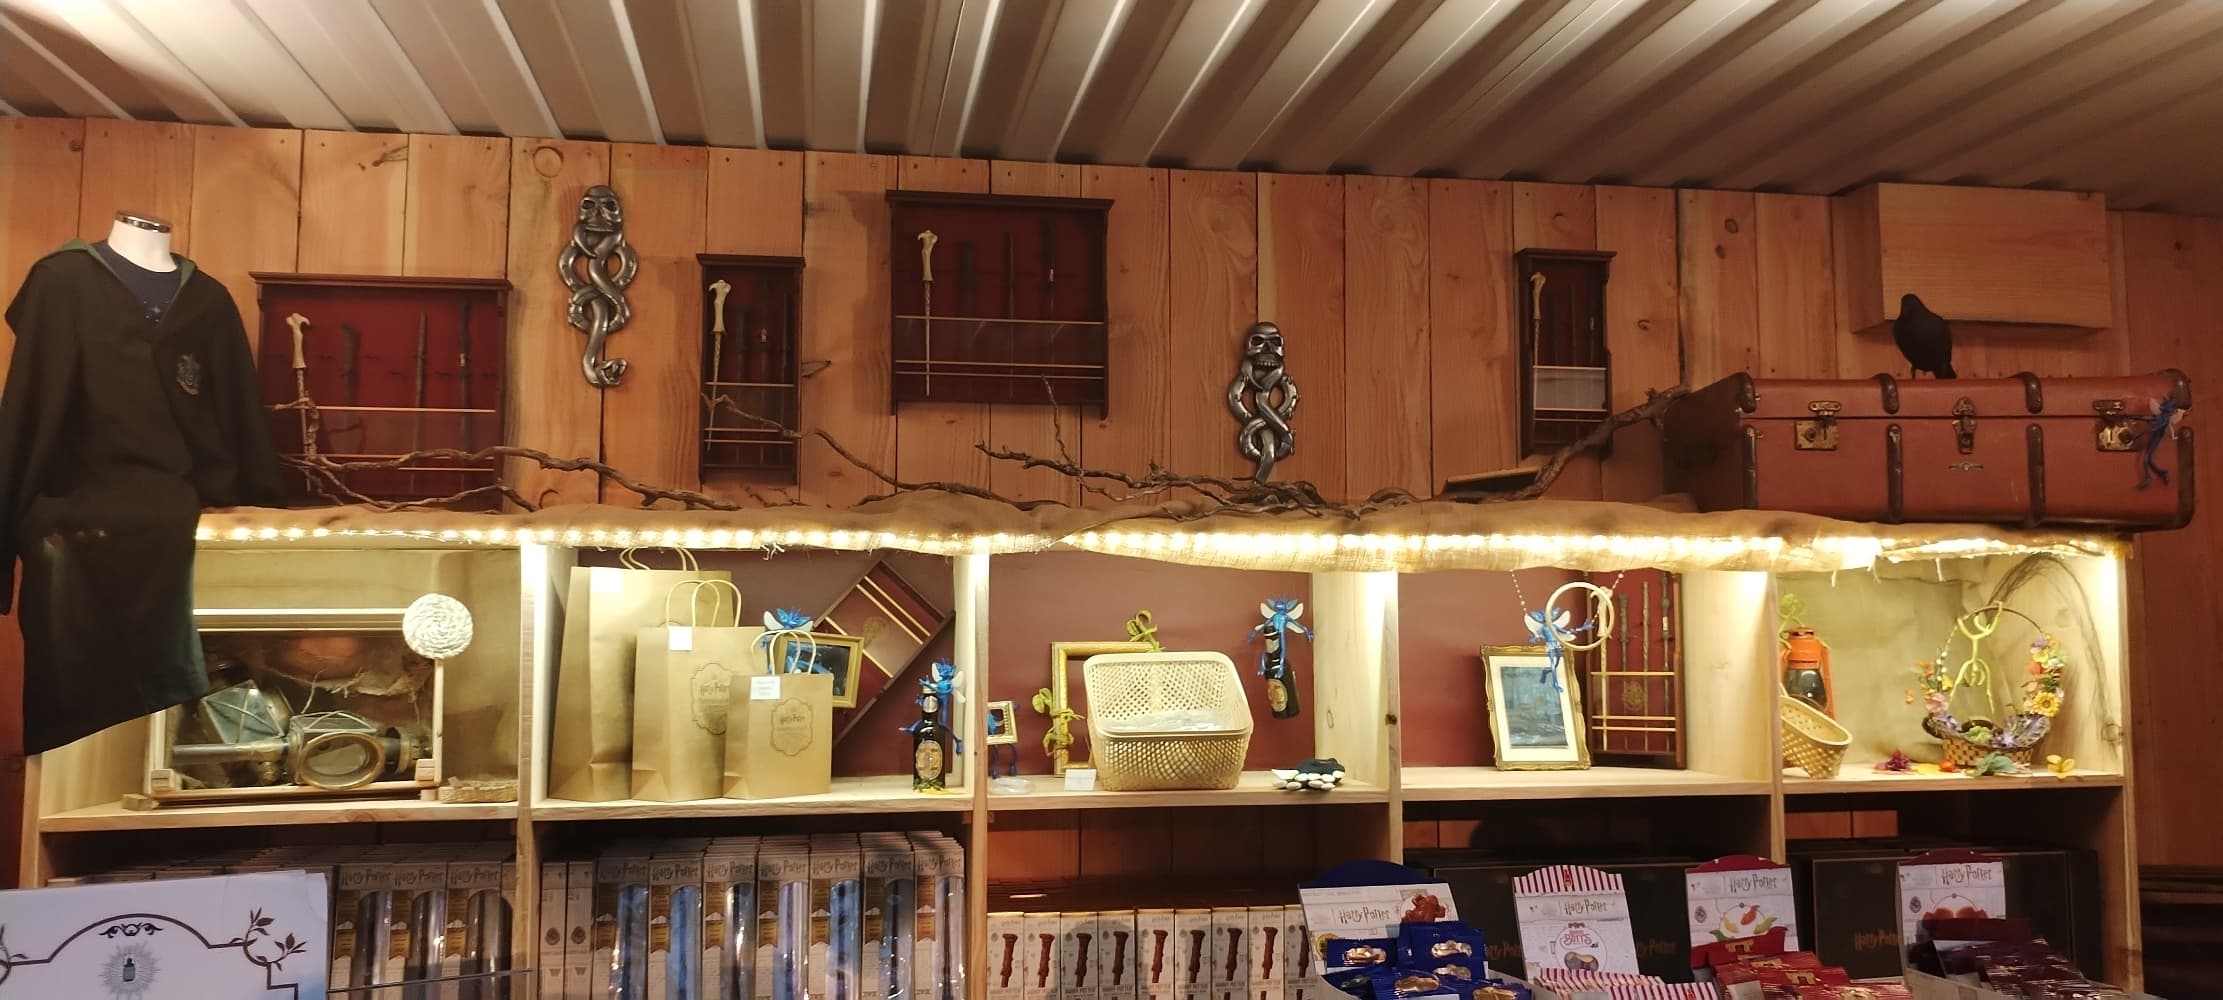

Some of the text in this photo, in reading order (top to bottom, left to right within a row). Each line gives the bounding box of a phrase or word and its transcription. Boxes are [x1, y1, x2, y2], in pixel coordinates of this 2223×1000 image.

[1730, 874, 1777, 893] Harry Potter
[1942, 865, 1992, 885] Harry Potter
[1339, 906, 1390, 924] Harry Potter
[1564, 899, 1607, 915] Harry Potter
